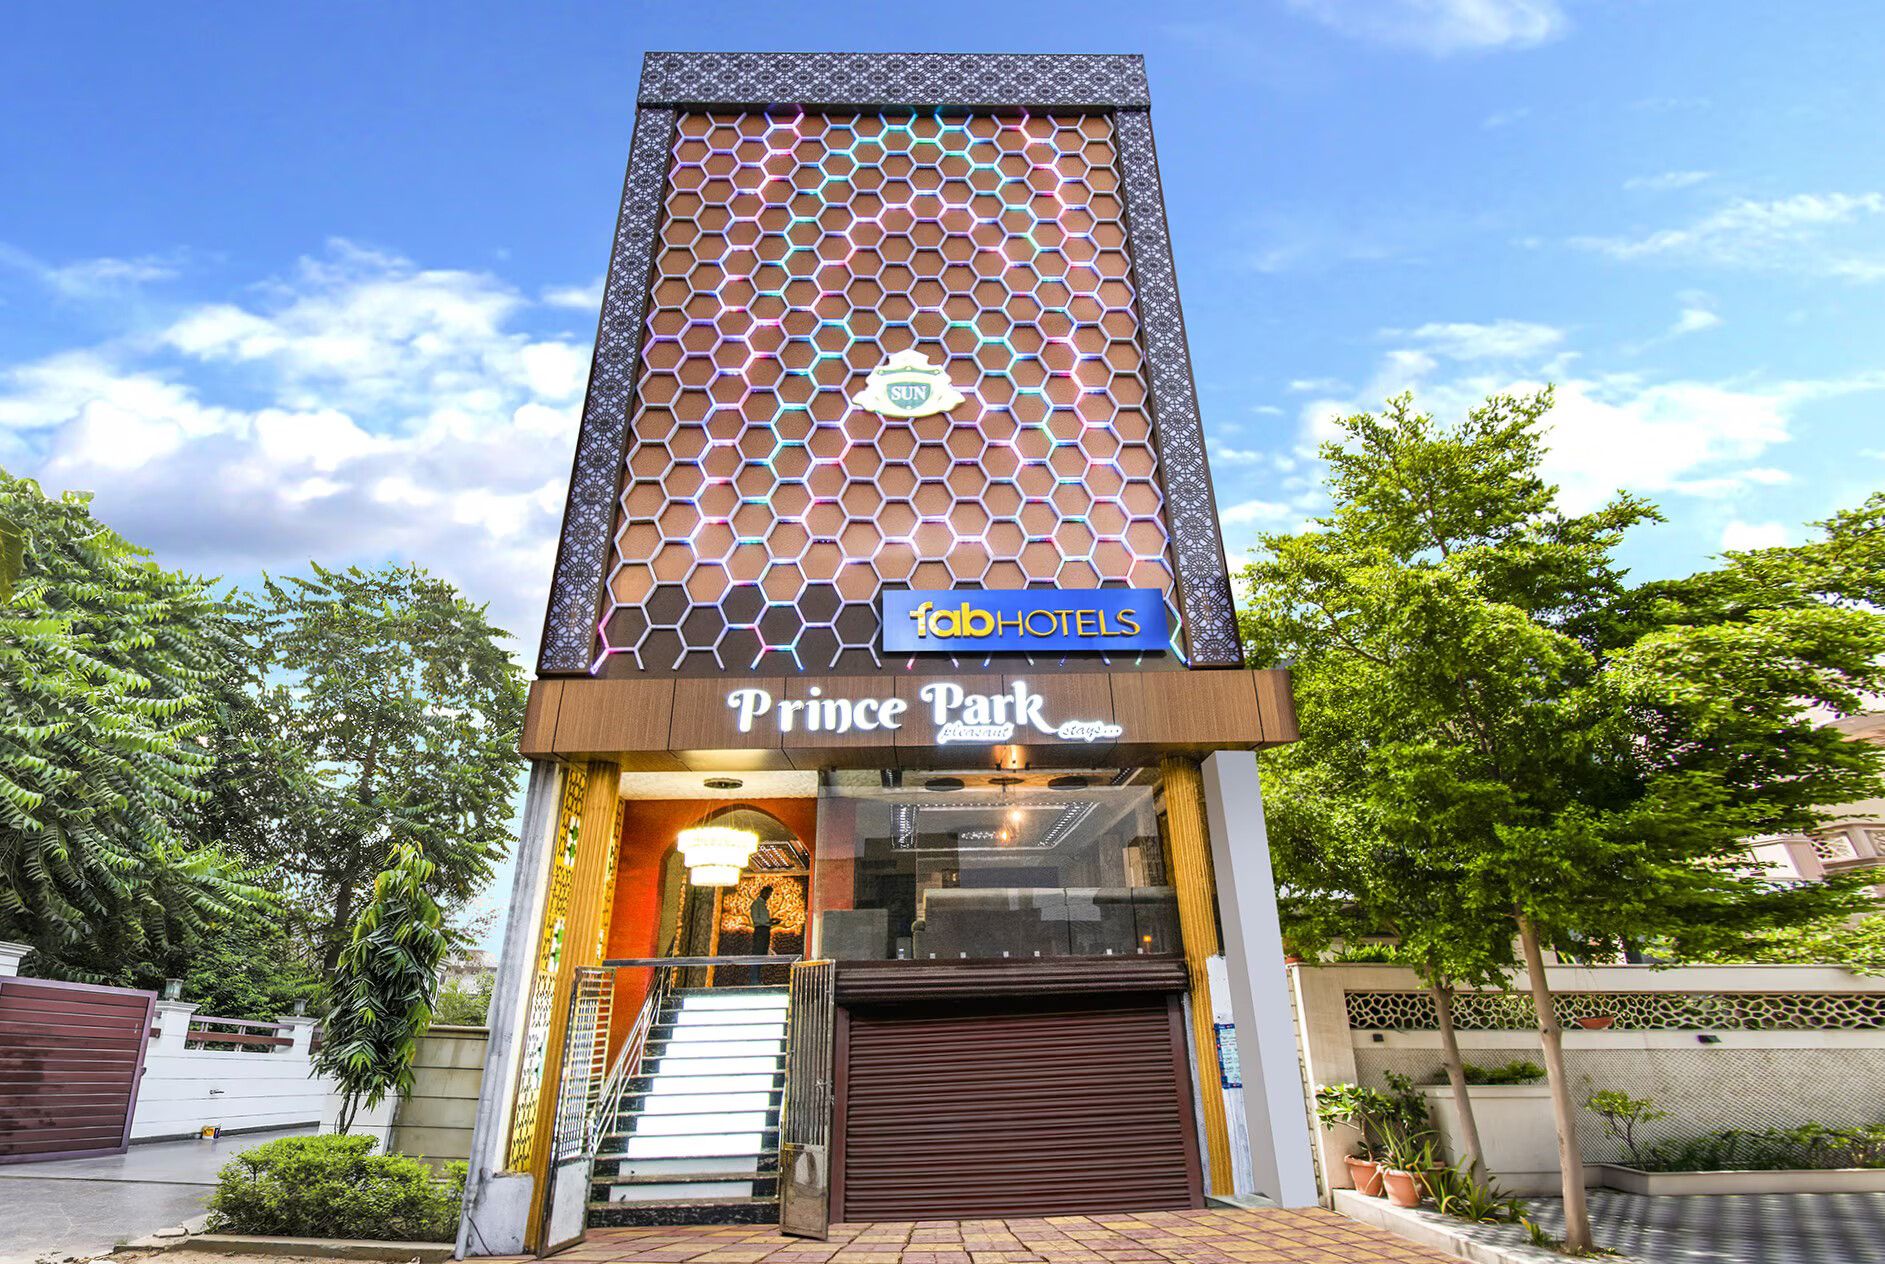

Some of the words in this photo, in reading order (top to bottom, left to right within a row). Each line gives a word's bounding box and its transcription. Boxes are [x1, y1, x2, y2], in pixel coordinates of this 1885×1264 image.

[891, 386, 927, 400] SUN
[727, 686, 908, 734] Prince
[920, 680, 1059, 734] Park
